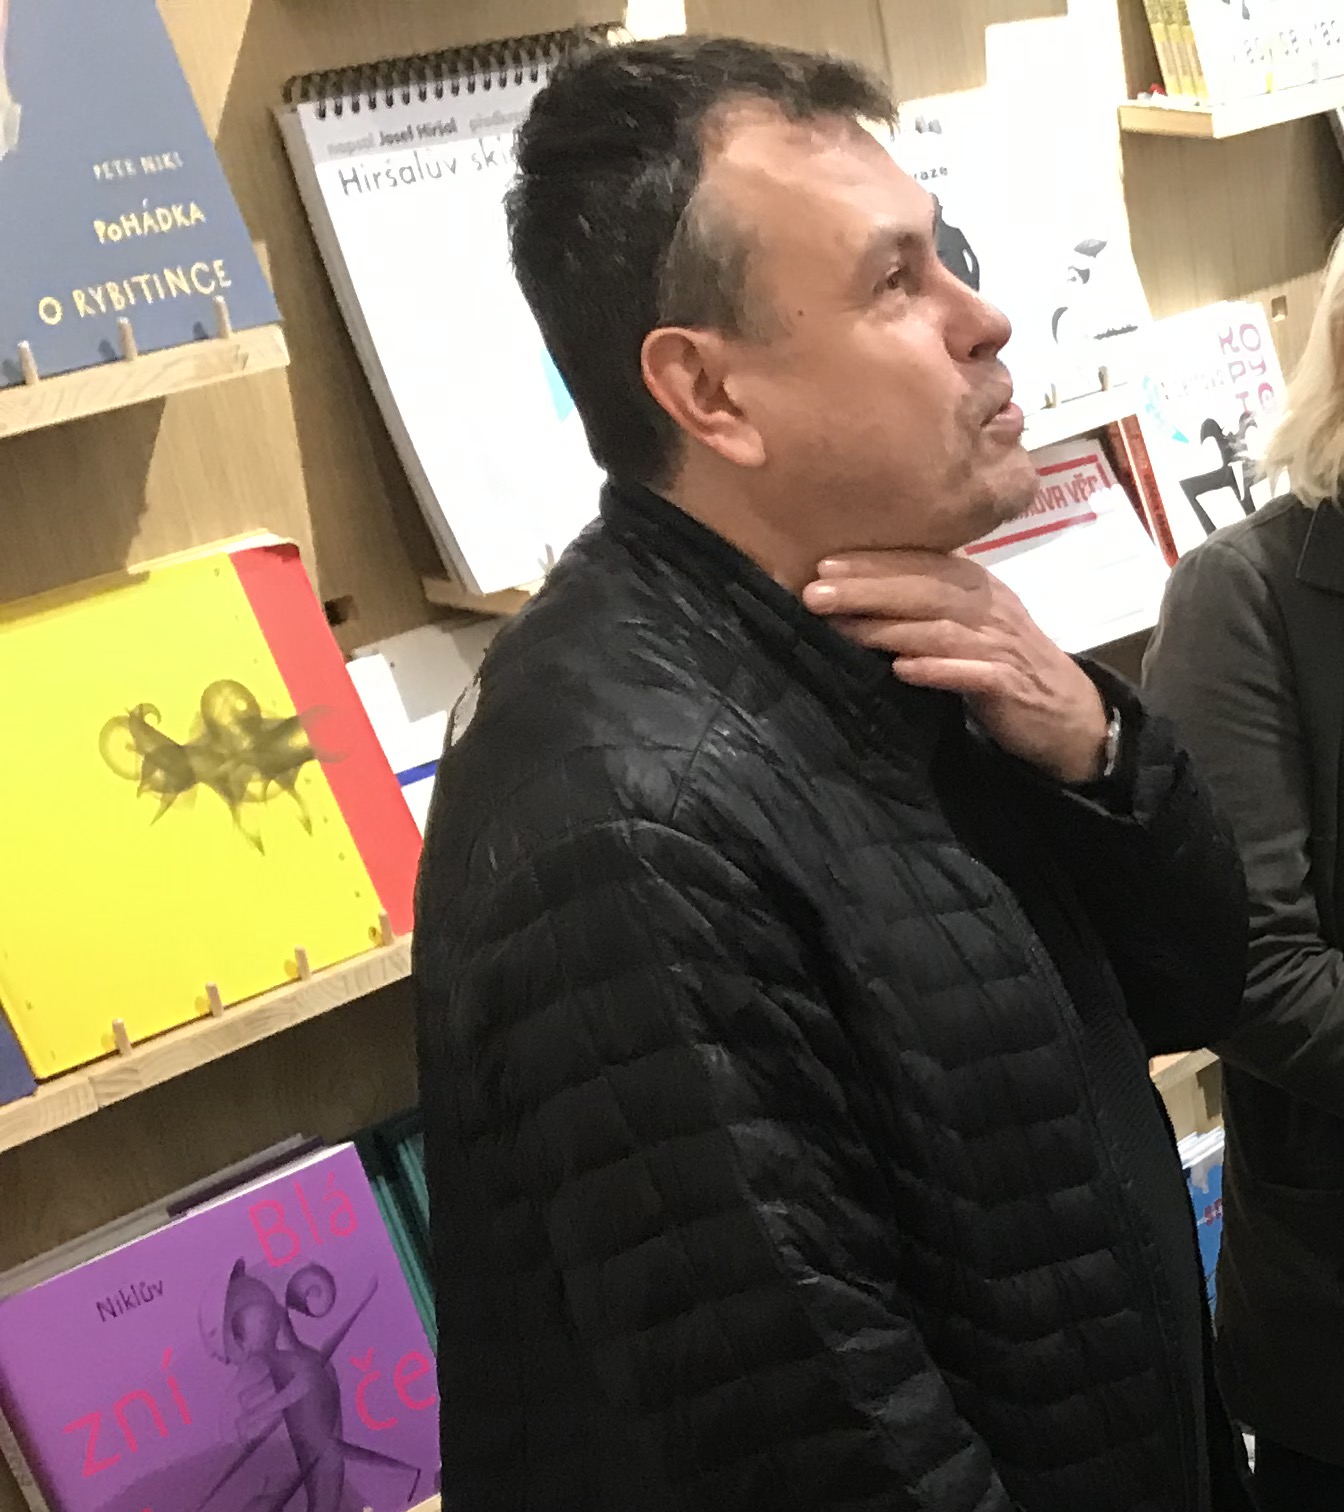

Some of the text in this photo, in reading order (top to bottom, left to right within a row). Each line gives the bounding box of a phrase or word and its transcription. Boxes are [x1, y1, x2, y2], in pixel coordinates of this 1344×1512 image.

[93, 198, 207, 244] POHÁDKA
[38, 258, 232, 326] O RYBITINCE
[249, 1172, 360, 1268] Blá
[95, 1278, 165, 1323] Niklův
[62, 1346, 192, 1478] zní
[348, 1346, 437, 1432] če
